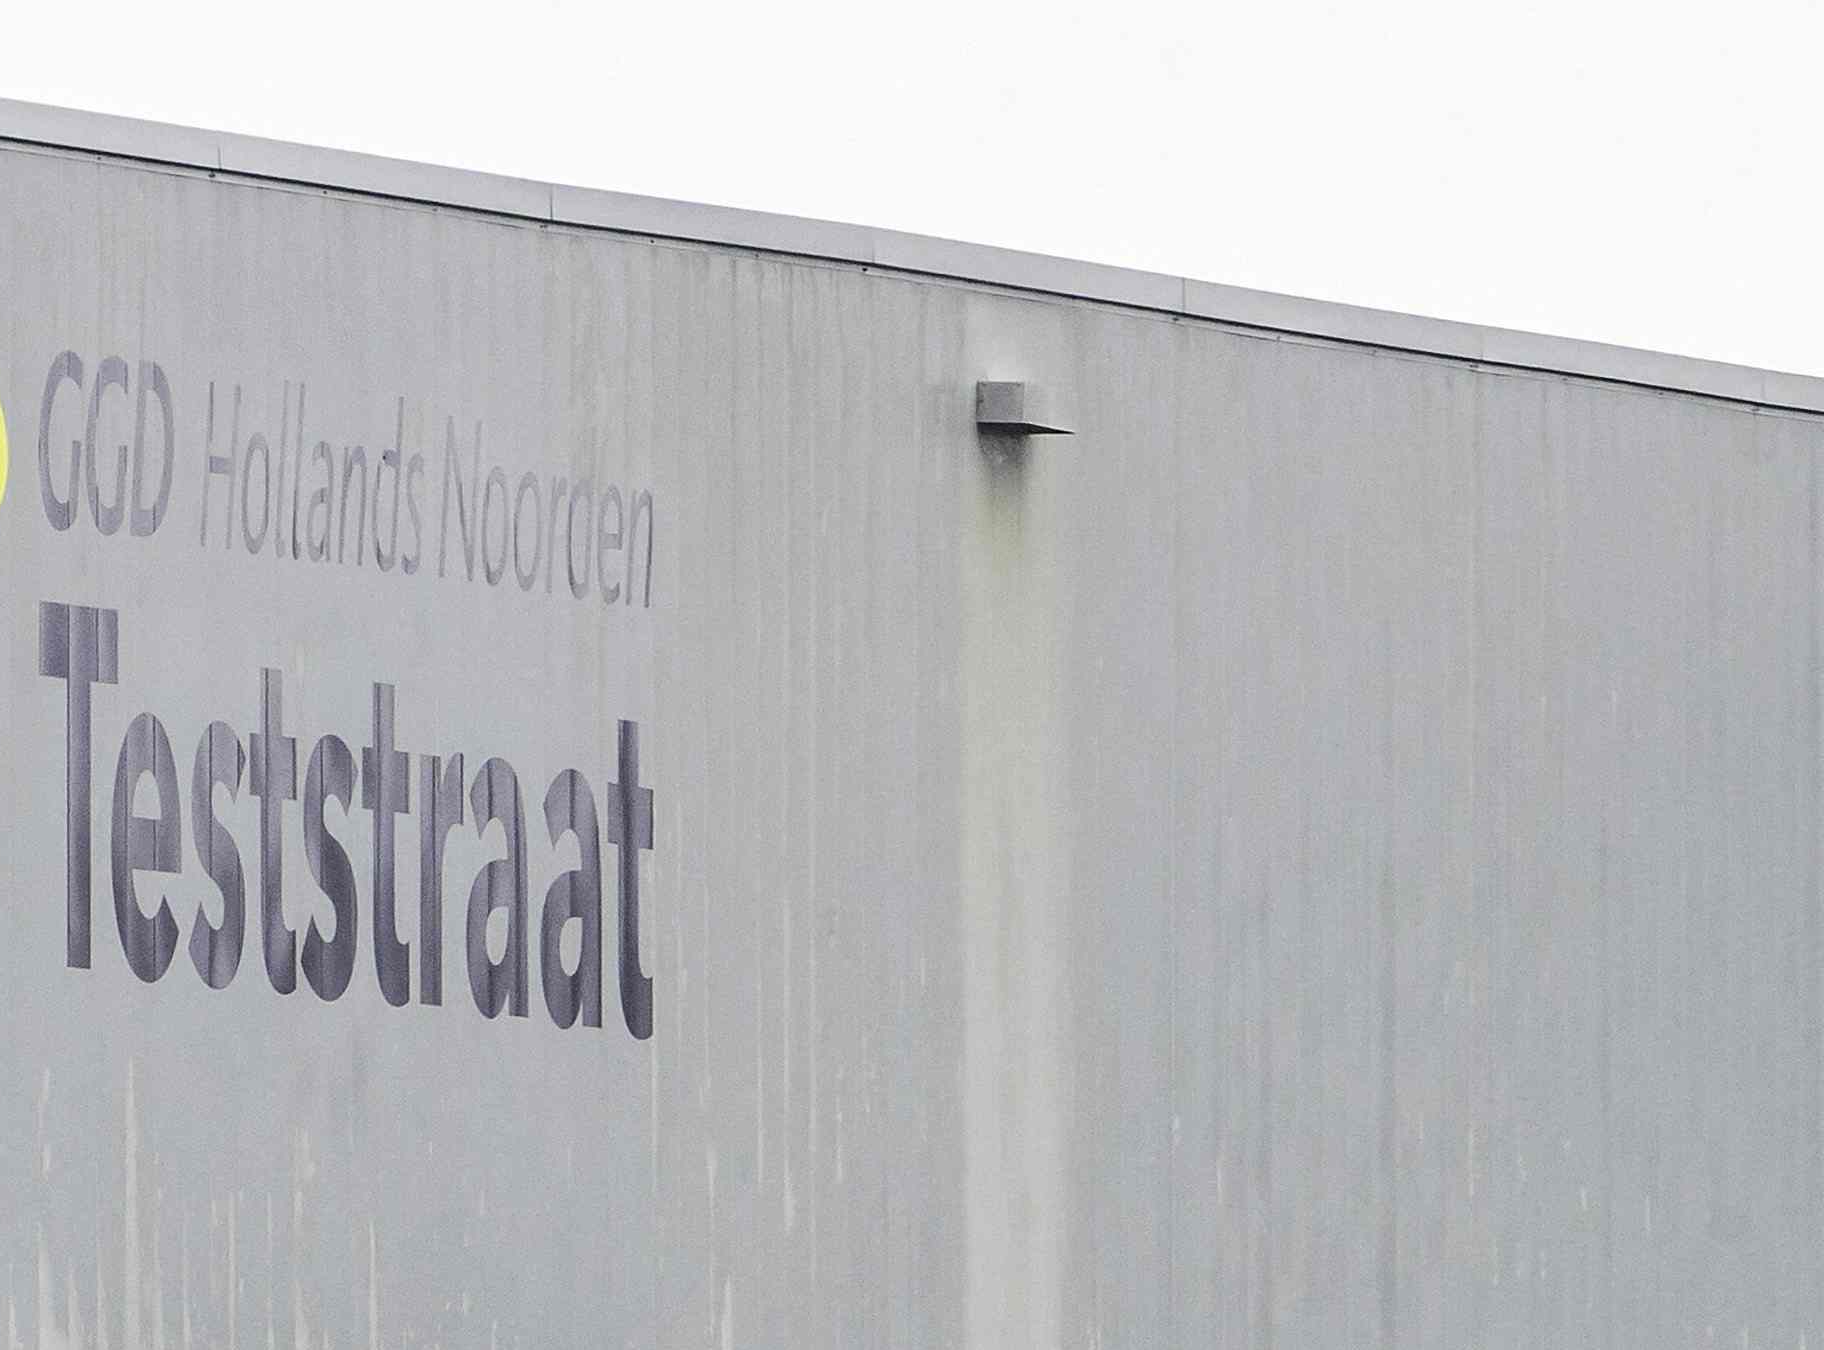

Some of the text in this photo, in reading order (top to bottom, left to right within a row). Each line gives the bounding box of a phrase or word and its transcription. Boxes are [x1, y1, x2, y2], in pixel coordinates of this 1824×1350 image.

[38, 350, 175, 536] GGD
[200, 378, 425, 575] Hollands
[39, 602, 654, 1041] Teststraat
